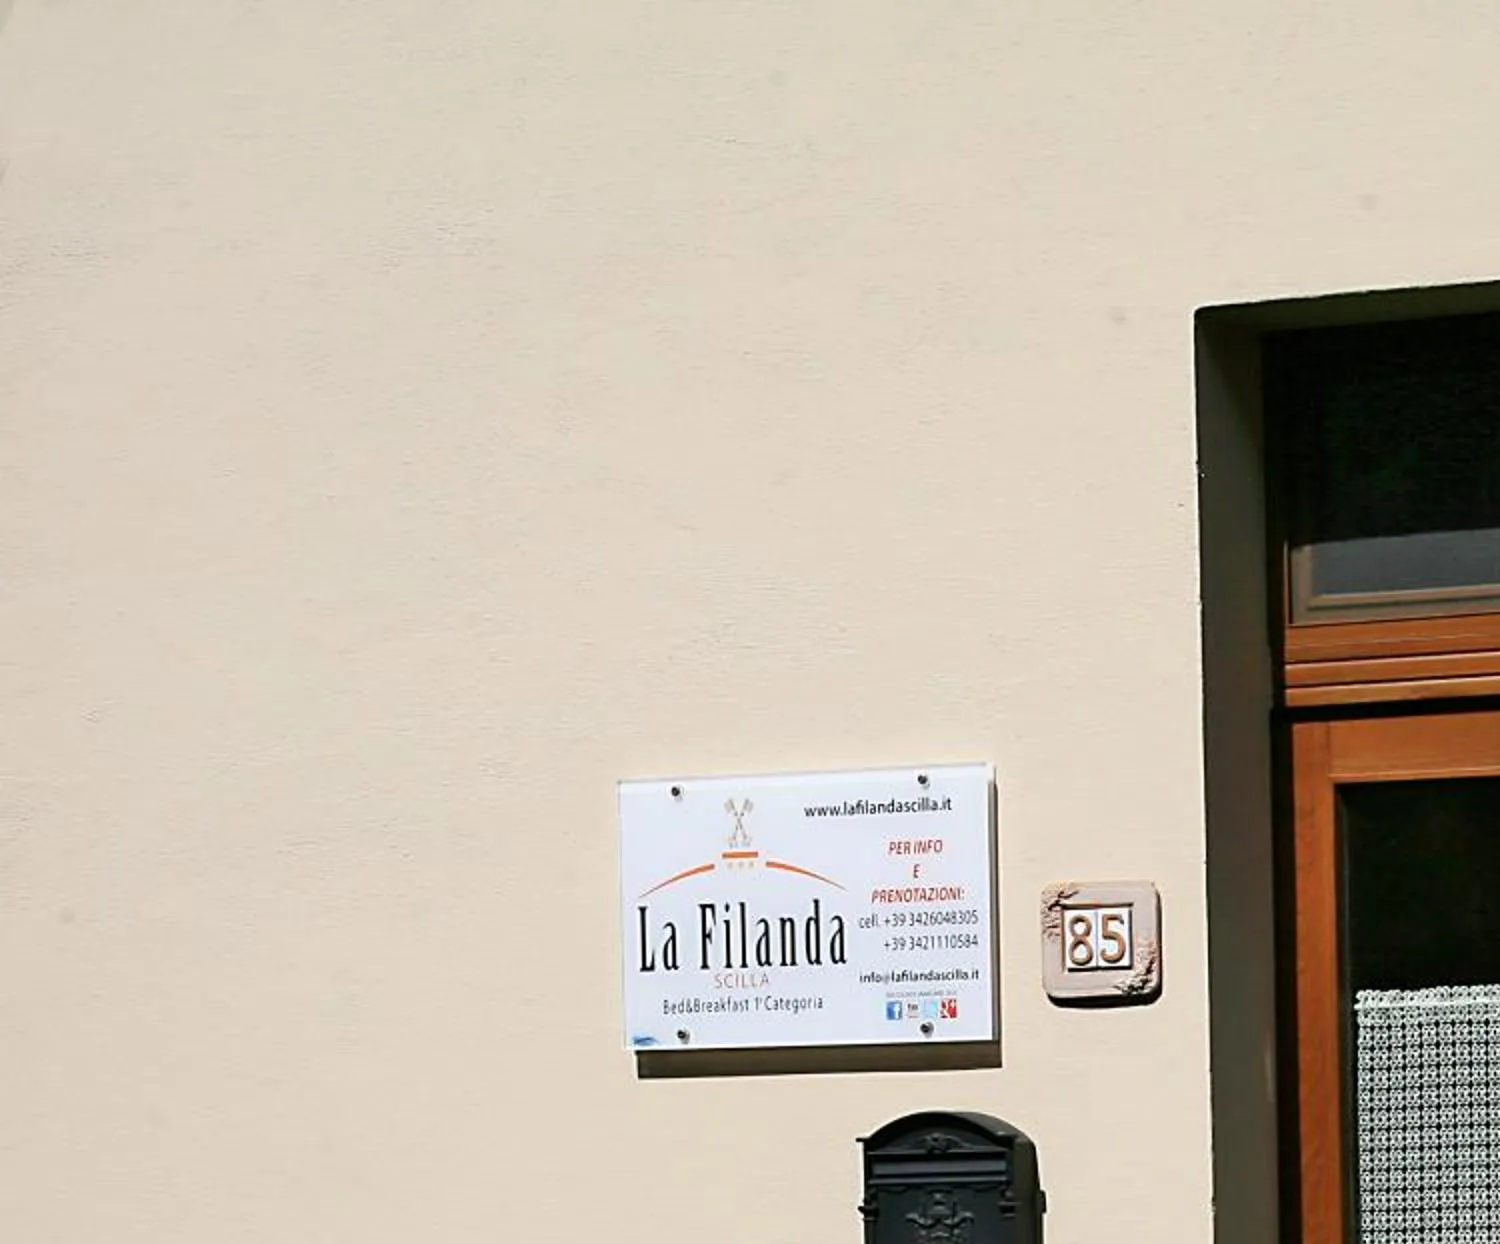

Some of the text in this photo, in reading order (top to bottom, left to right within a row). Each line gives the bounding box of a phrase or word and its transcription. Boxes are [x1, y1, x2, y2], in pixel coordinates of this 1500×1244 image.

[804, 796, 953, 818] www.lafilandascilla.it
[888, 839, 944, 856] PER INFO
[913, 864, 921, 879] E
[871, 888, 965, 904] PRENOTAZIONI:
[884, 912, 906, 927] +39
[638, 898, 848, 972] La Filanda
[1069, 914, 1126, 966] 85
[884, 937, 906, 951] +39
[713, 972, 770, 989] SCILLA
[663, 998, 749, 1015] Bed&Breakfast
